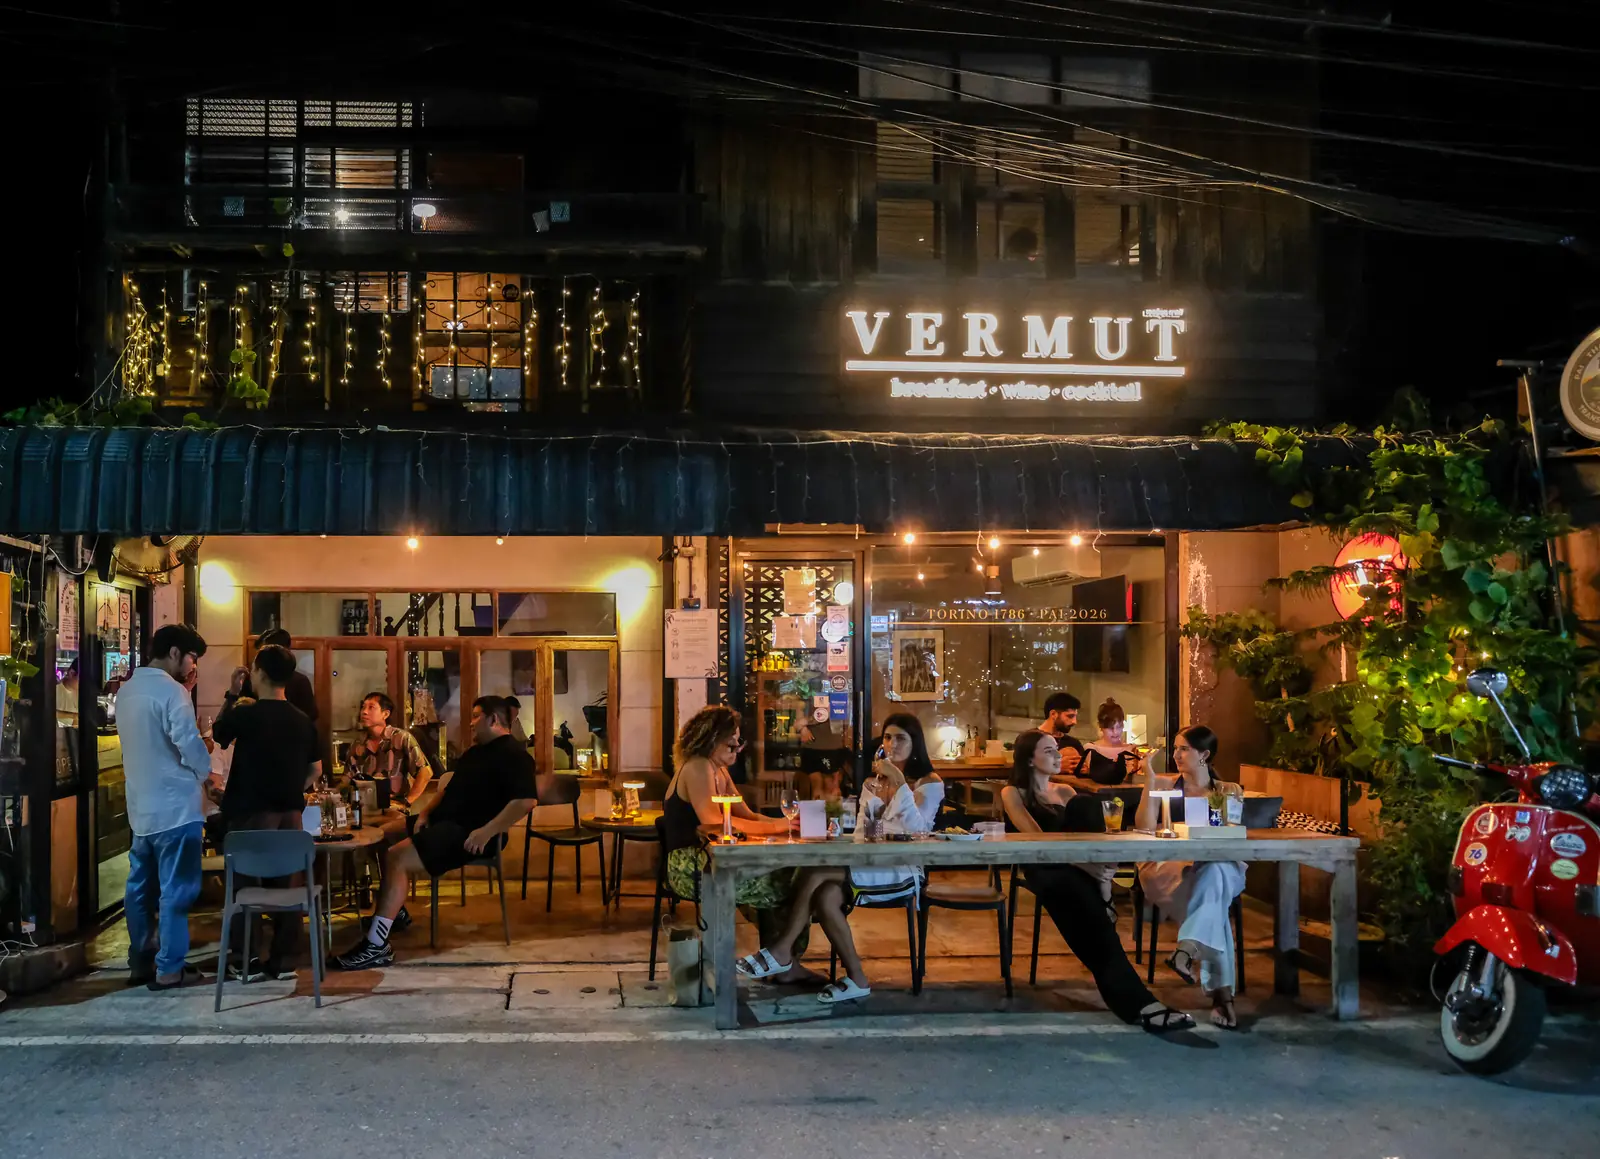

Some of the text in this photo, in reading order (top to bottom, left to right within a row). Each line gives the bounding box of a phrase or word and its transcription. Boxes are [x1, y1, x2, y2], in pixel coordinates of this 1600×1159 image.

[846, 311, 1185, 361] VERMUT
[927, 608, 989, 620] TORINO
[994, 608, 1026, 620] 1786
[1069, 608, 1108, 620] 2026
[56, 756, 73, 774] OPE
[1468, 848, 1482, 859] 76
